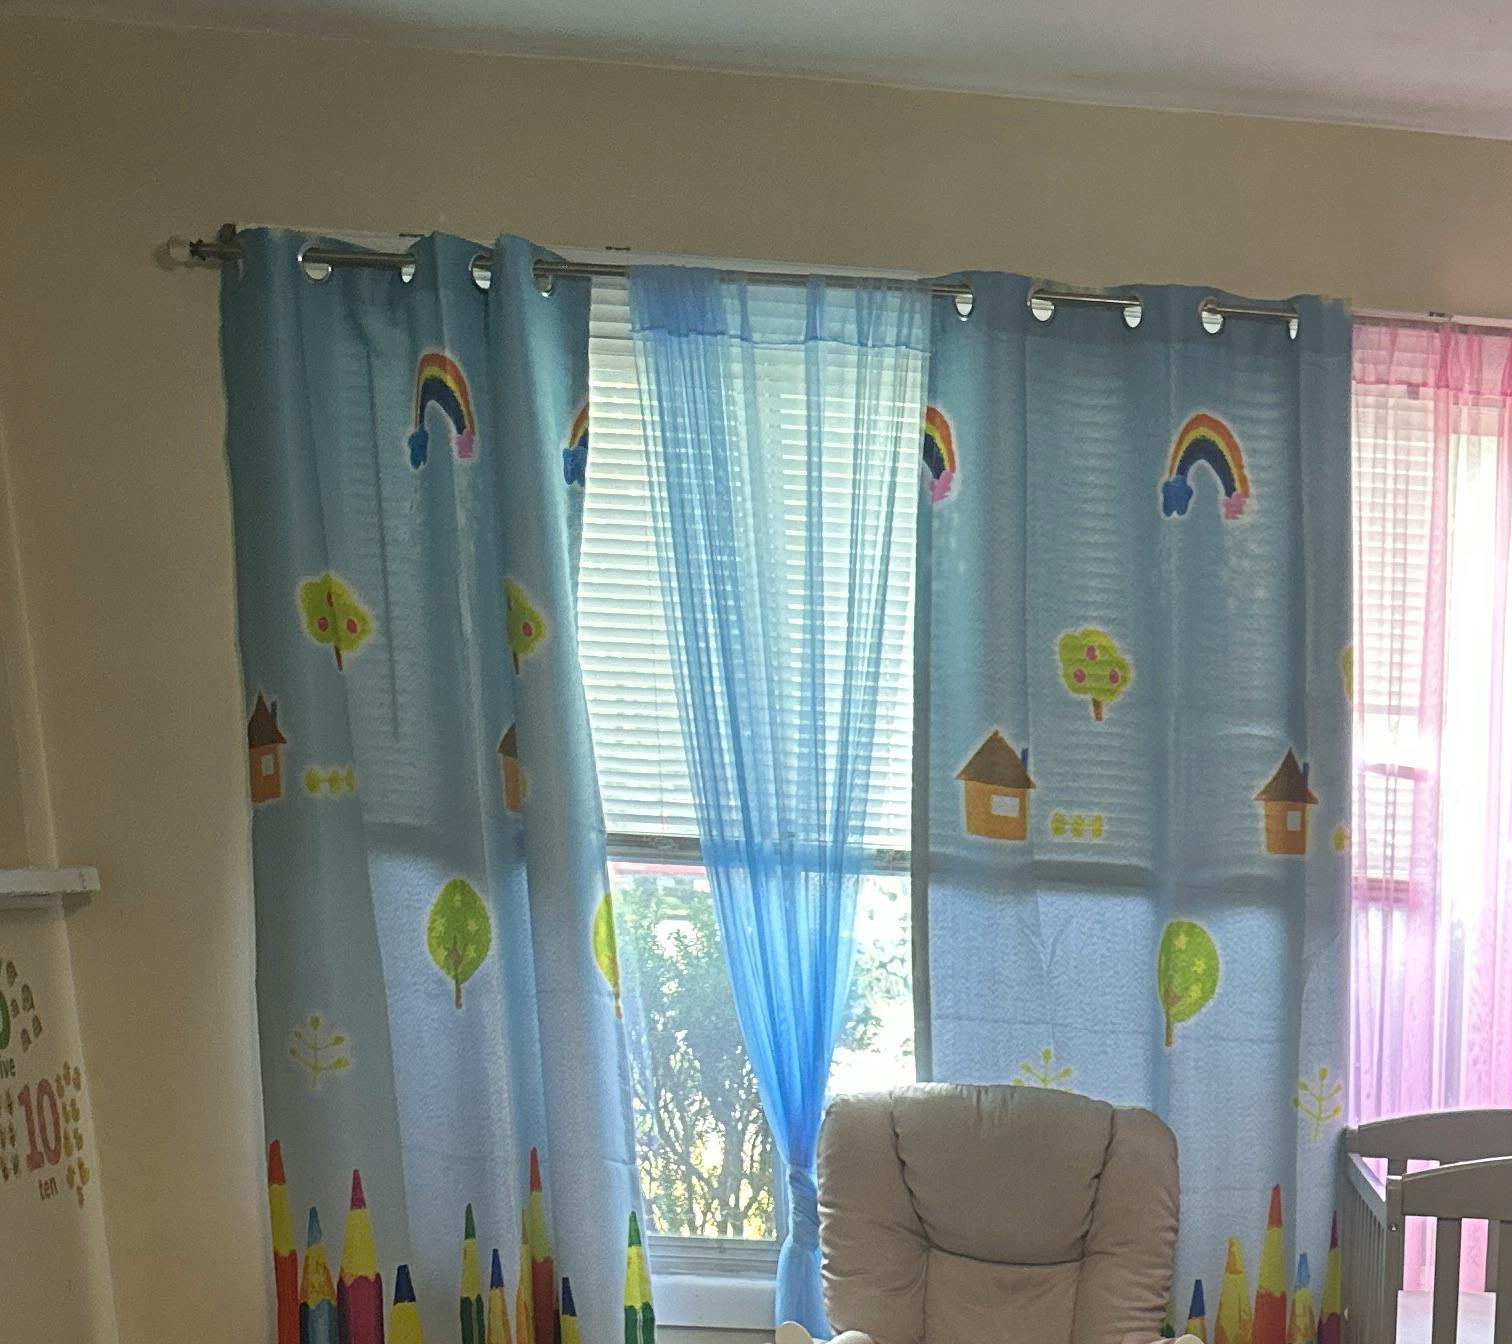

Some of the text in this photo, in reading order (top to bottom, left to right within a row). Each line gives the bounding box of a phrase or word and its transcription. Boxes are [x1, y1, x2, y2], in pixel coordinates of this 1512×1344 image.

[0, 1055, 16, 1079] ive
[17, 1078, 62, 1171] 10
[38, 1176, 59, 1200] ten
